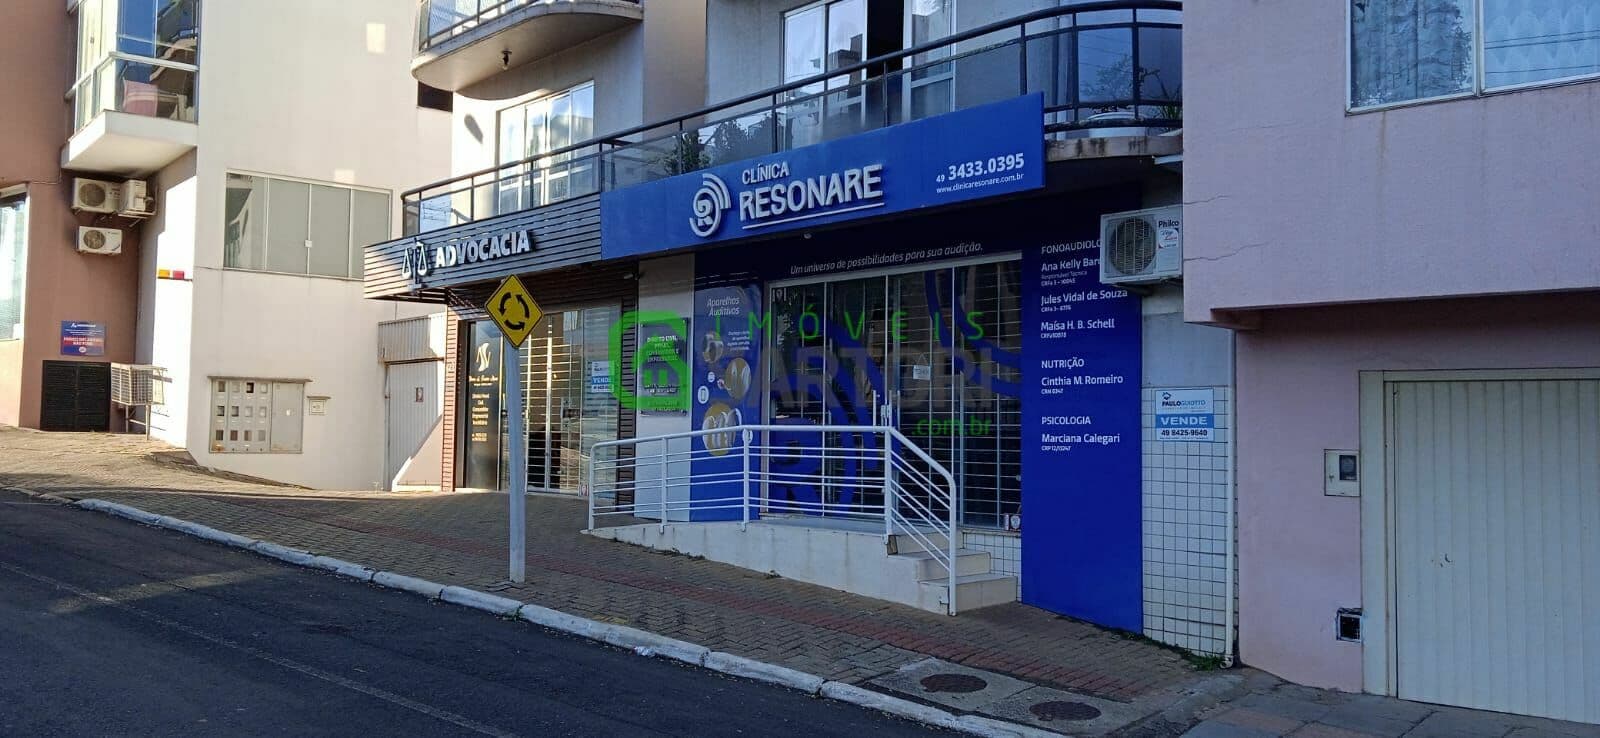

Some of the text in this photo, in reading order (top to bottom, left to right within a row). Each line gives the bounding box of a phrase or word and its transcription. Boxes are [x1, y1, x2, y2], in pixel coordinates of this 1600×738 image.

[742, 161, 790, 185] CLÍNICA
[936, 152, 1025, 182] 49 3433.0395
[936, 172, 1024, 193] www.clinicaresonare.com.br
[739, 163, 884, 221] RESONARE
[1158, 219, 1180, 228] Philco
[435, 230, 530, 268] ADVOCACIA
[790, 265, 803, 274] Um
[804, 262, 835, 273] universo
[836, 259, 847, 269] de
[847, 252, 904, 270] possibilidades
[905, 250, 926, 263] para
[927, 248, 943, 258] sua
[1041, 263, 1058, 272] Ana
[1060, 259, 1081, 270] Kelly
[1041, 289, 1128, 306] Jules Vidal de Souza
[1041, 318, 1115, 332] Maísa H. B. Schell
[1041, 356, 1085, 370] NUTRIÇÃO
[1041, 374, 1124, 386] Cinthia M. Romeiro
[1041, 416, 1091, 425] PSICOLOGIA
[1160, 416, 1208, 426] VENDE
[1041, 433, 1121, 446] Marciana Calegari
